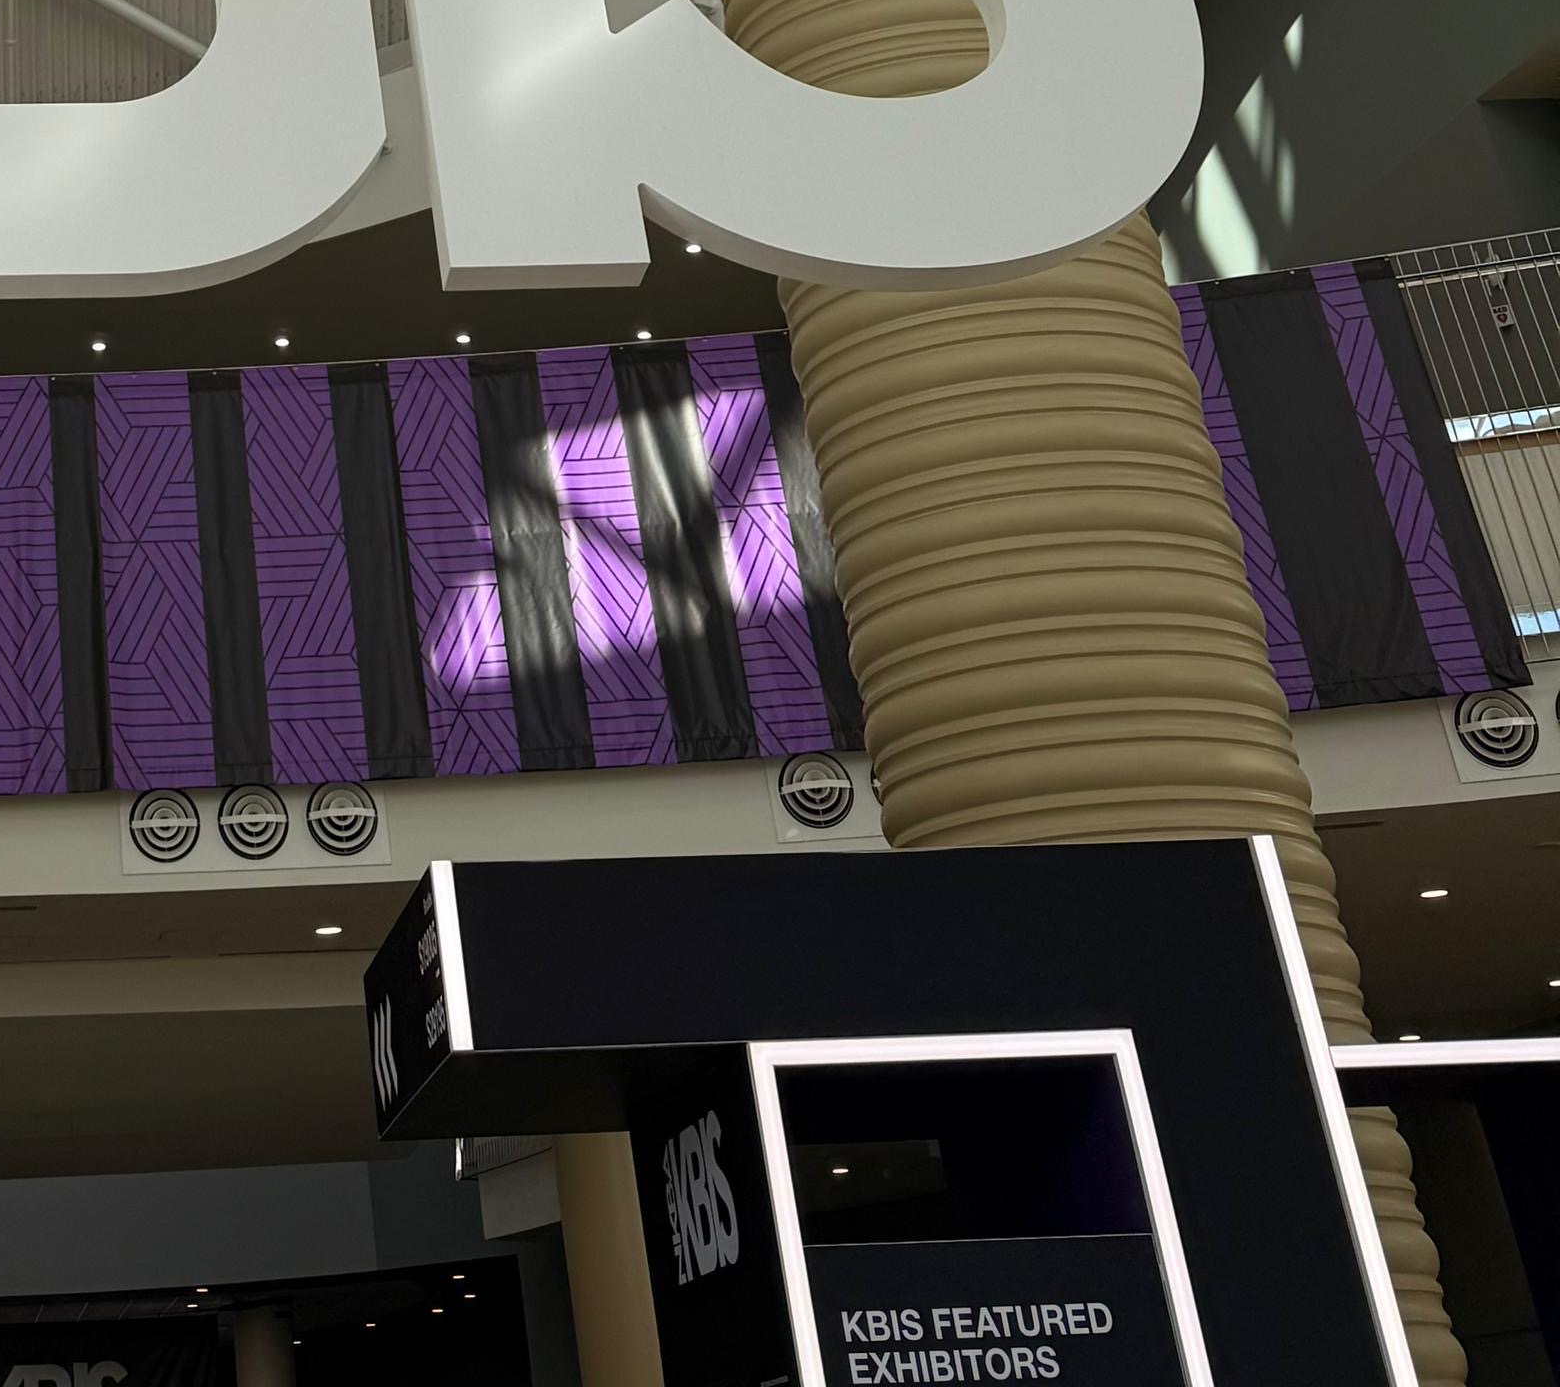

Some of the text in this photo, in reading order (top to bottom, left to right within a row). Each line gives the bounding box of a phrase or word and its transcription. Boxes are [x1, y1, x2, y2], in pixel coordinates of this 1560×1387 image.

[668, 1109, 740, 1283] KBIS
[841, 1302, 1113, 1343] KBIS FEATURED
[848, 1345, 1060, 1385] EXHIBITORS
